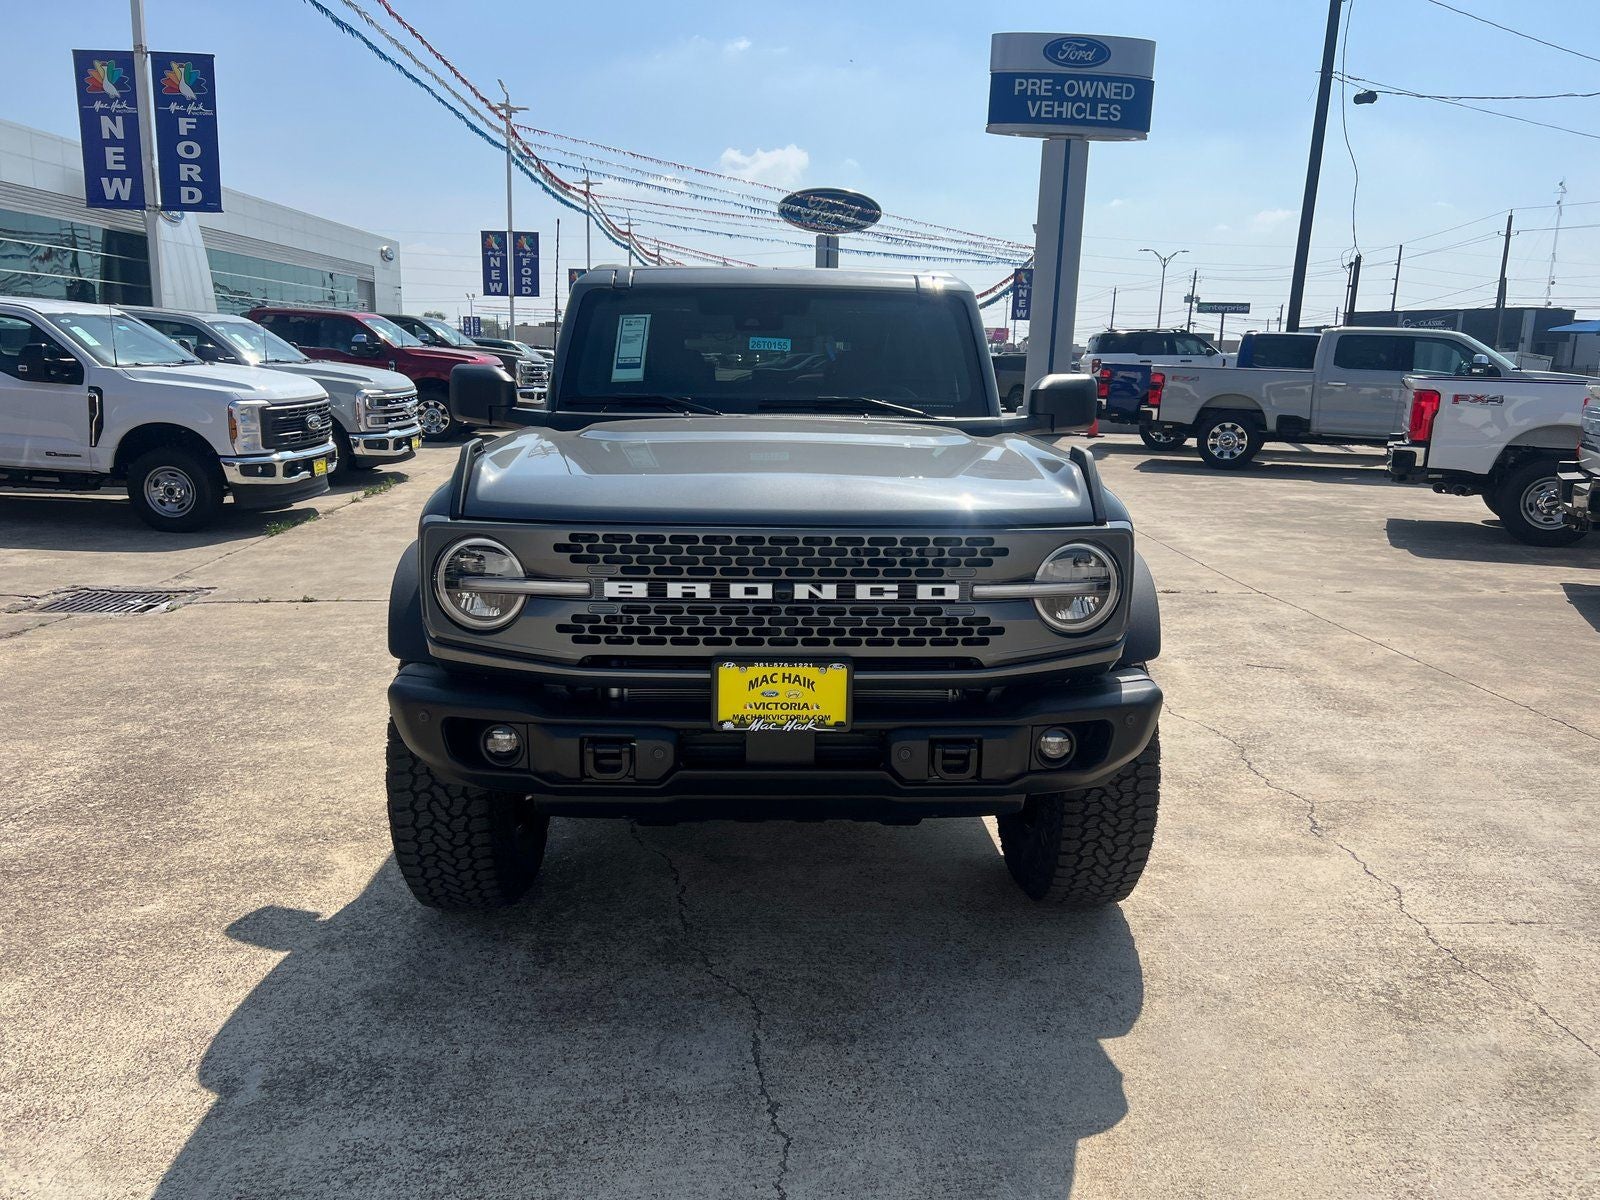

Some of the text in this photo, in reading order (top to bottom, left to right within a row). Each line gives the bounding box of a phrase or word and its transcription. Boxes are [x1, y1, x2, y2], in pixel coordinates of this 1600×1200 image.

[1057, 41, 1097, 61] Ford
[1027, 101, 1121, 121] VEHICLES
[100, 116, 132, 201] NEW
[176, 117, 203, 204] FORD
[489, 257, 503, 293] NEW
[521, 258, 532, 295] FORD
[1016, 289, 1028, 318] NEW
[751, 340, 788, 350] 26T0155
[1452, 394, 1504, 404] FX4
[603, 581, 960, 600] BRONCO
[748, 672, 816, 692] MAC HAIK
[753, 702, 810, 711] VICTORIA
[732, 713, 831, 721] MACHAIKVICTORIA.COM
[747, 719, 819, 731] Mac Haik
